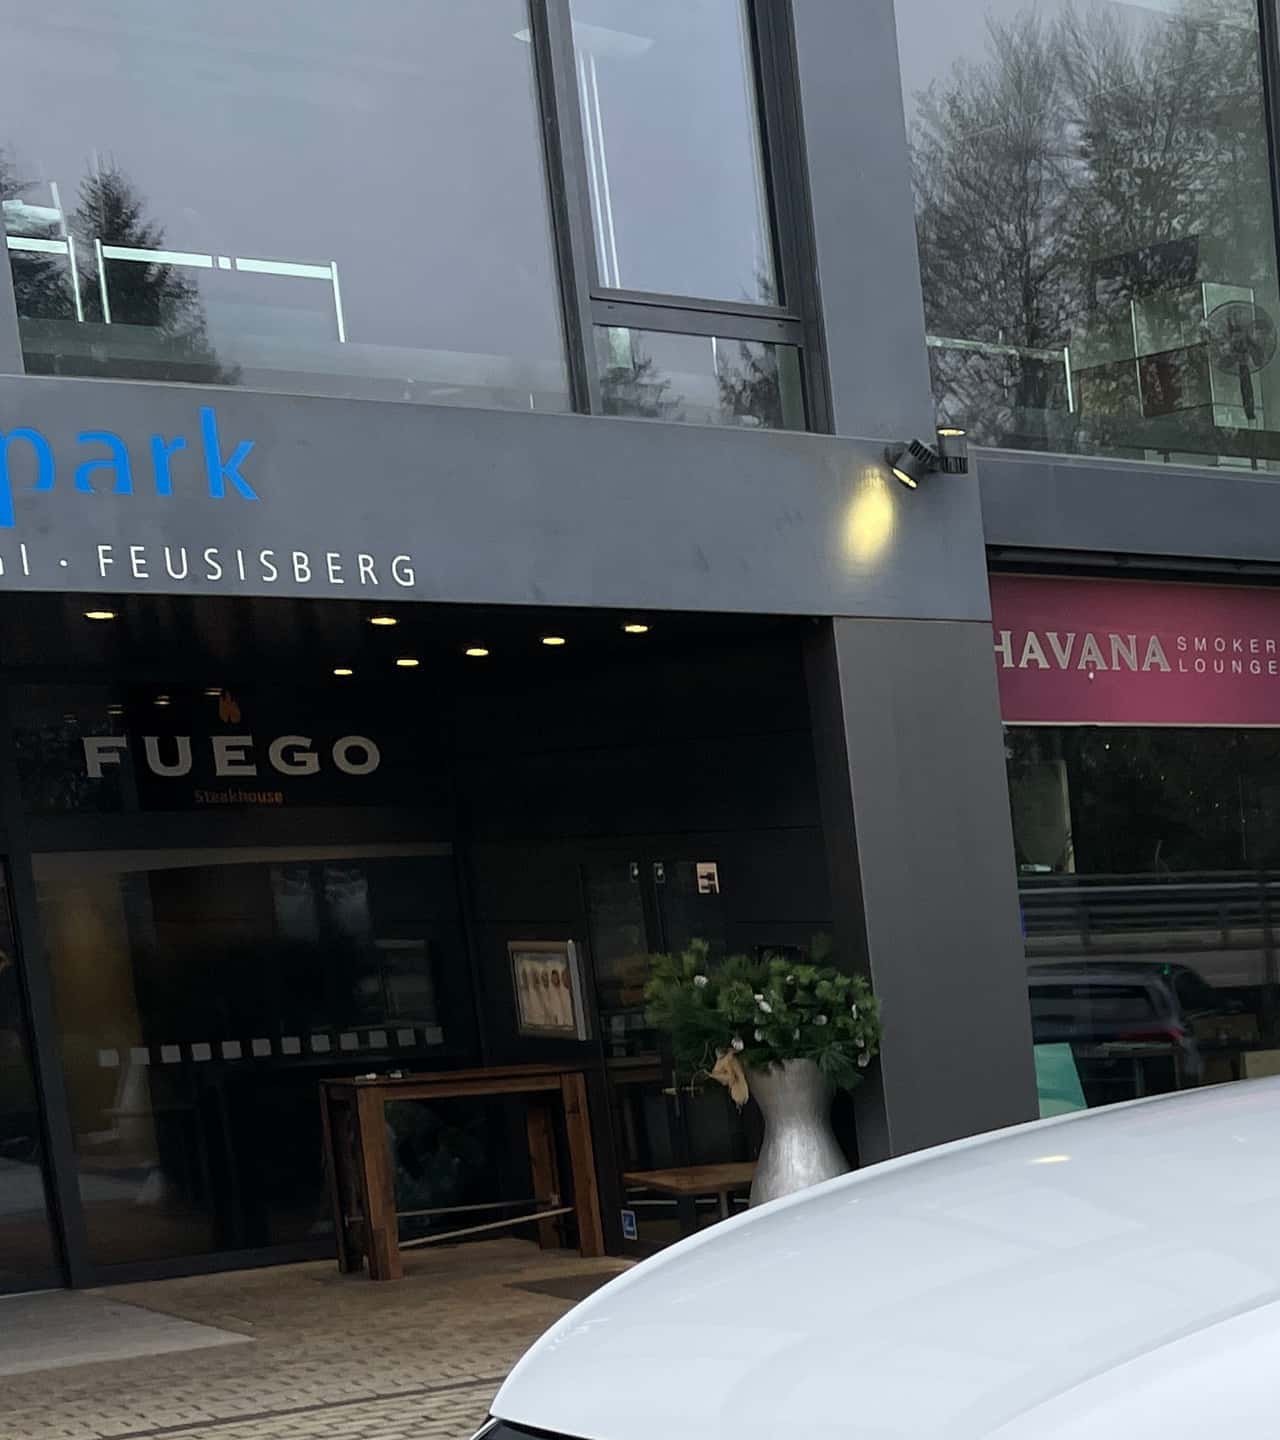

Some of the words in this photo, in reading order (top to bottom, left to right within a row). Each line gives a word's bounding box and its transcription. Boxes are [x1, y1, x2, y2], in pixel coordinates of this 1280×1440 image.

[0, 406, 260, 529] park
[98, 544, 416, 587] FEUSISBERG
[994, 630, 1172, 672] HAVANA
[1176, 635, 1277, 654] SMOKER
[1177, 658, 1279, 675] LOUNGE
[81, 735, 381, 778] FUEGO
